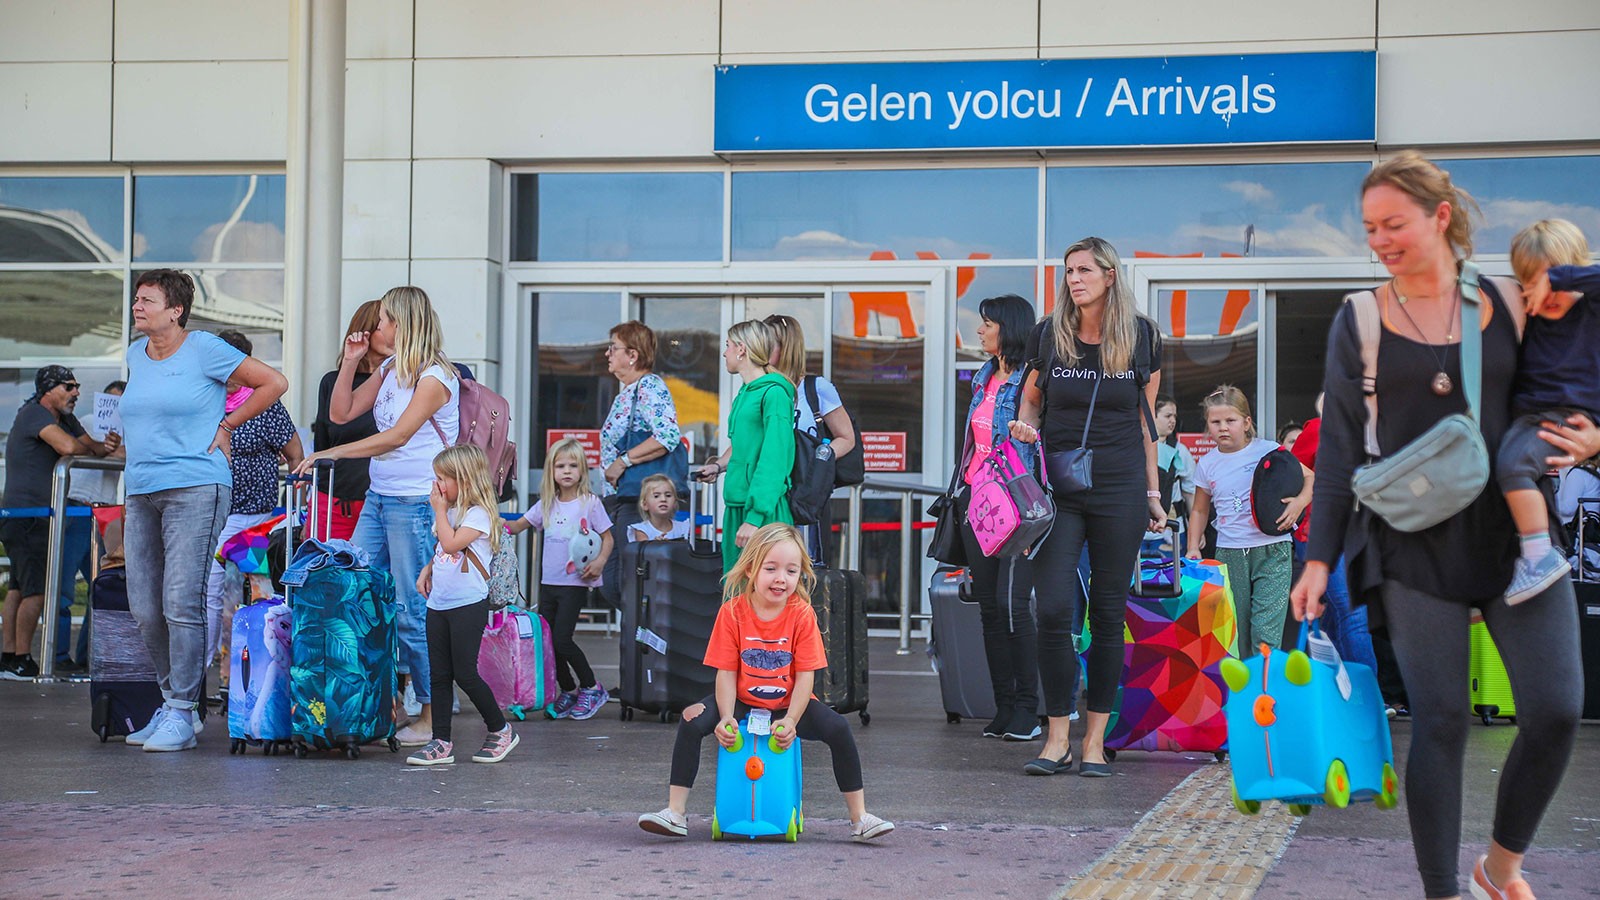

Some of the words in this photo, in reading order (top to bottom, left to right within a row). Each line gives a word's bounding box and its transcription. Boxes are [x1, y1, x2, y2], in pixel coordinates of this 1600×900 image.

[804, 83, 932, 123] Gelen
[947, 80, 1061, 130] yolcu
[1075, 77, 1093, 118] /
[1105, 74, 1277, 118] Arrivals
[1051, 366, 1097, 380] Calvin
